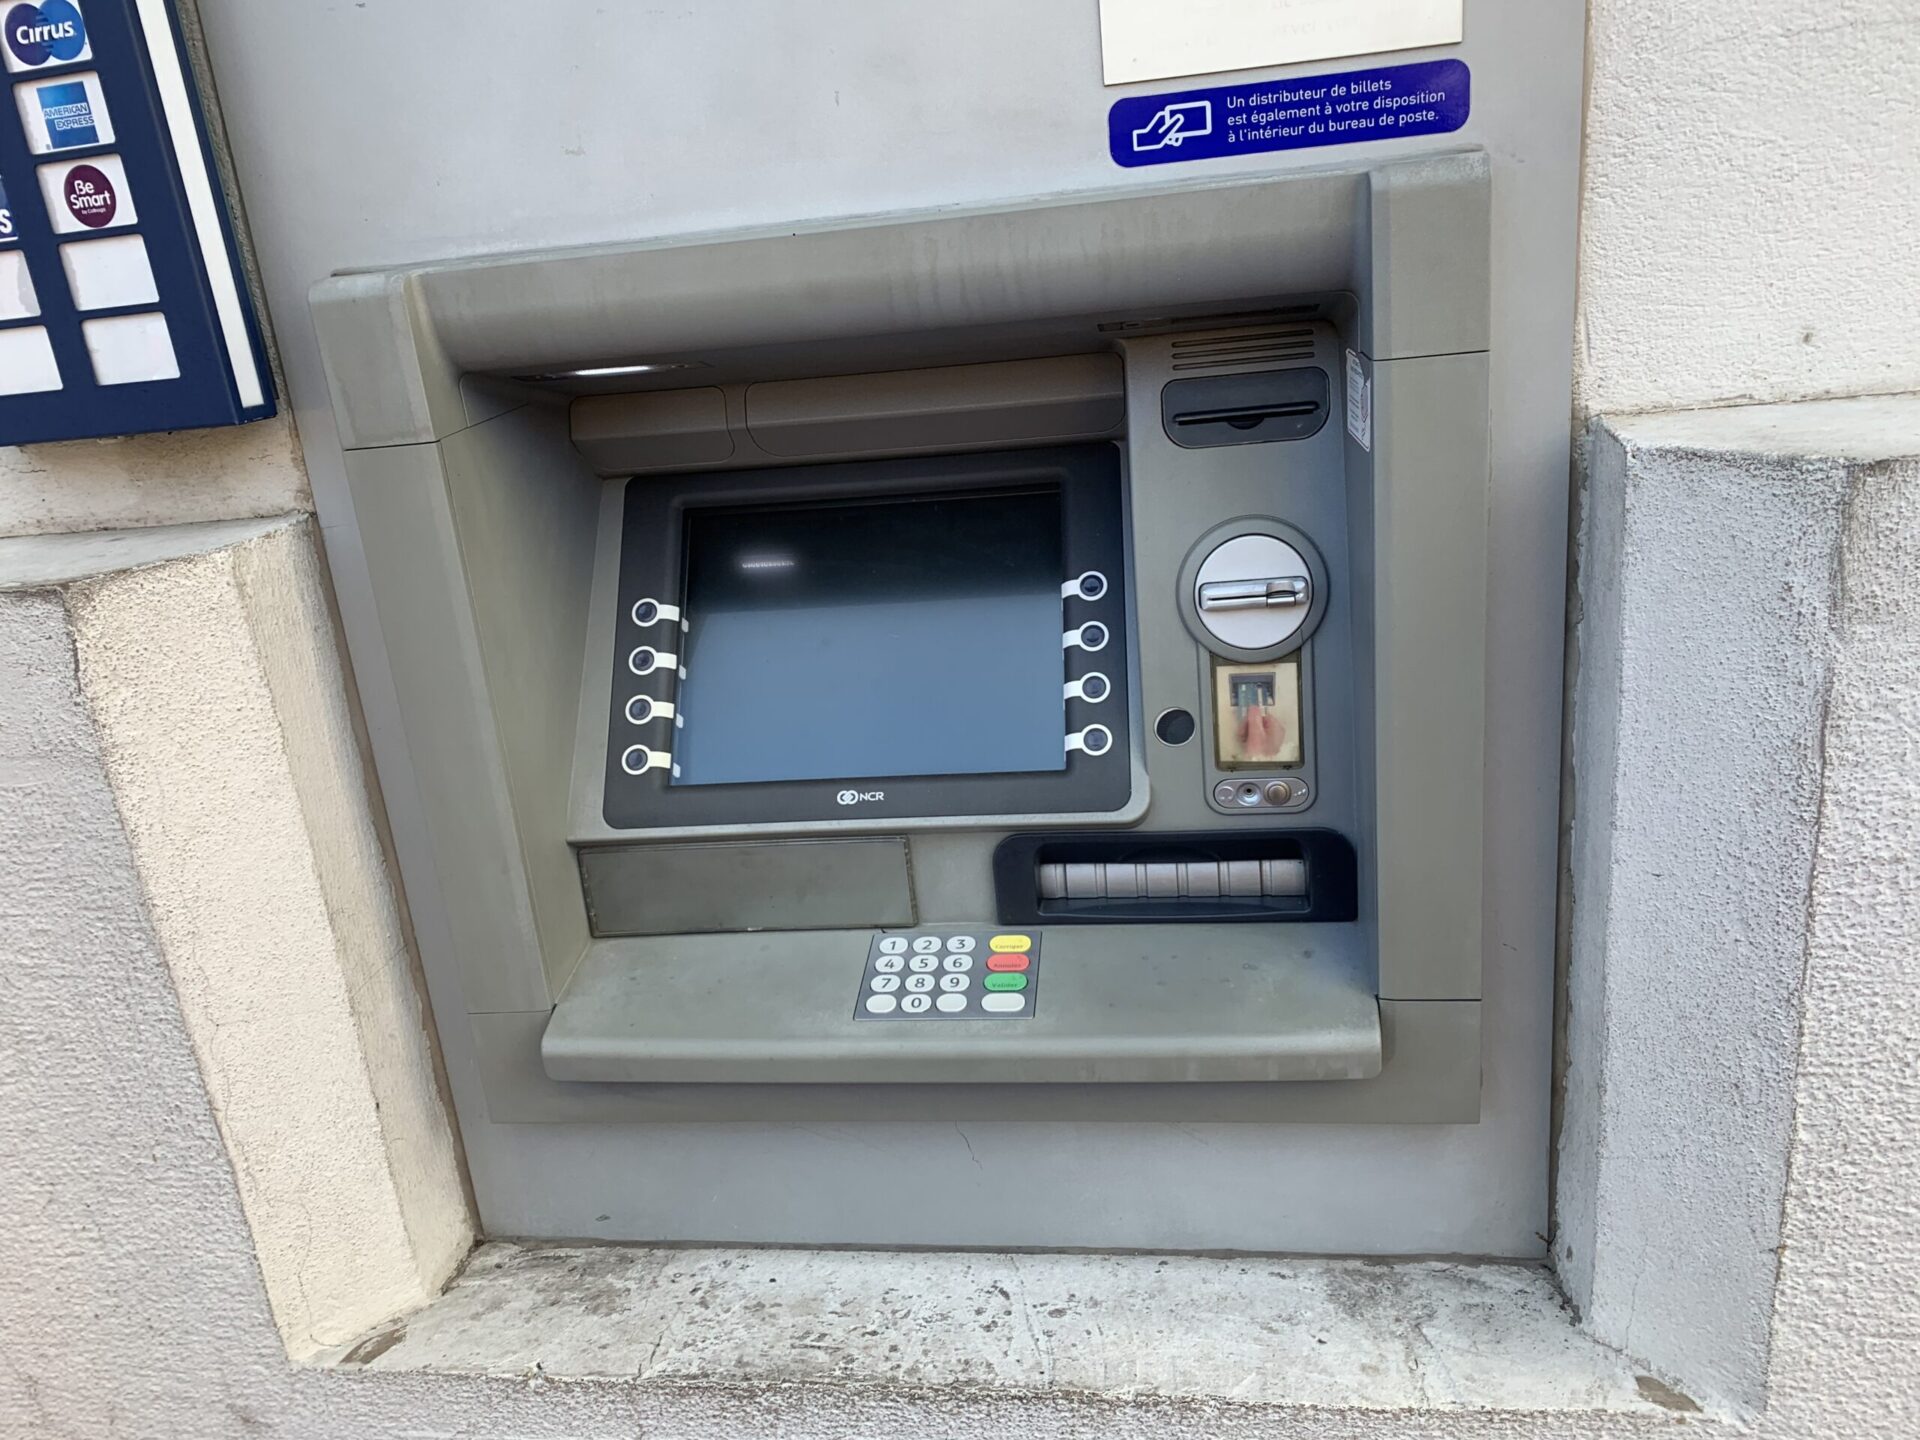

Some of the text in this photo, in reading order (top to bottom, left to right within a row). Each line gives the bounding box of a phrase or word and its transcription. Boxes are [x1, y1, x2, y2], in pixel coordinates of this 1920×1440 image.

[16, 21, 75, 45] Cirrus
[1227, 79, 1392, 108] Un distributeur de billets
[43, 103, 88, 119] AMERICAN
[1227, 91, 1445, 126] est également à votre disposition
[55, 115, 95, 130] EXPRESS
[1228, 109, 1439, 143] à l'intérieur du bureau de poste.
[74, 180, 95, 195] Be
[70, 190, 111, 209] Smart
[859, 792, 884, 801] NCR
[889, 940, 896, 951] 1
[921, 939, 932, 950] 2
[955, 938, 966, 950] 3
[884, 958, 895, 969] 4
[918, 958, 929, 969] 5
[952, 957, 963, 969] 6
[881, 978, 892, 988] 7
[914, 977, 926, 988] 8
[950, 977, 960, 988] 9
[911, 997, 922, 1009] 0
